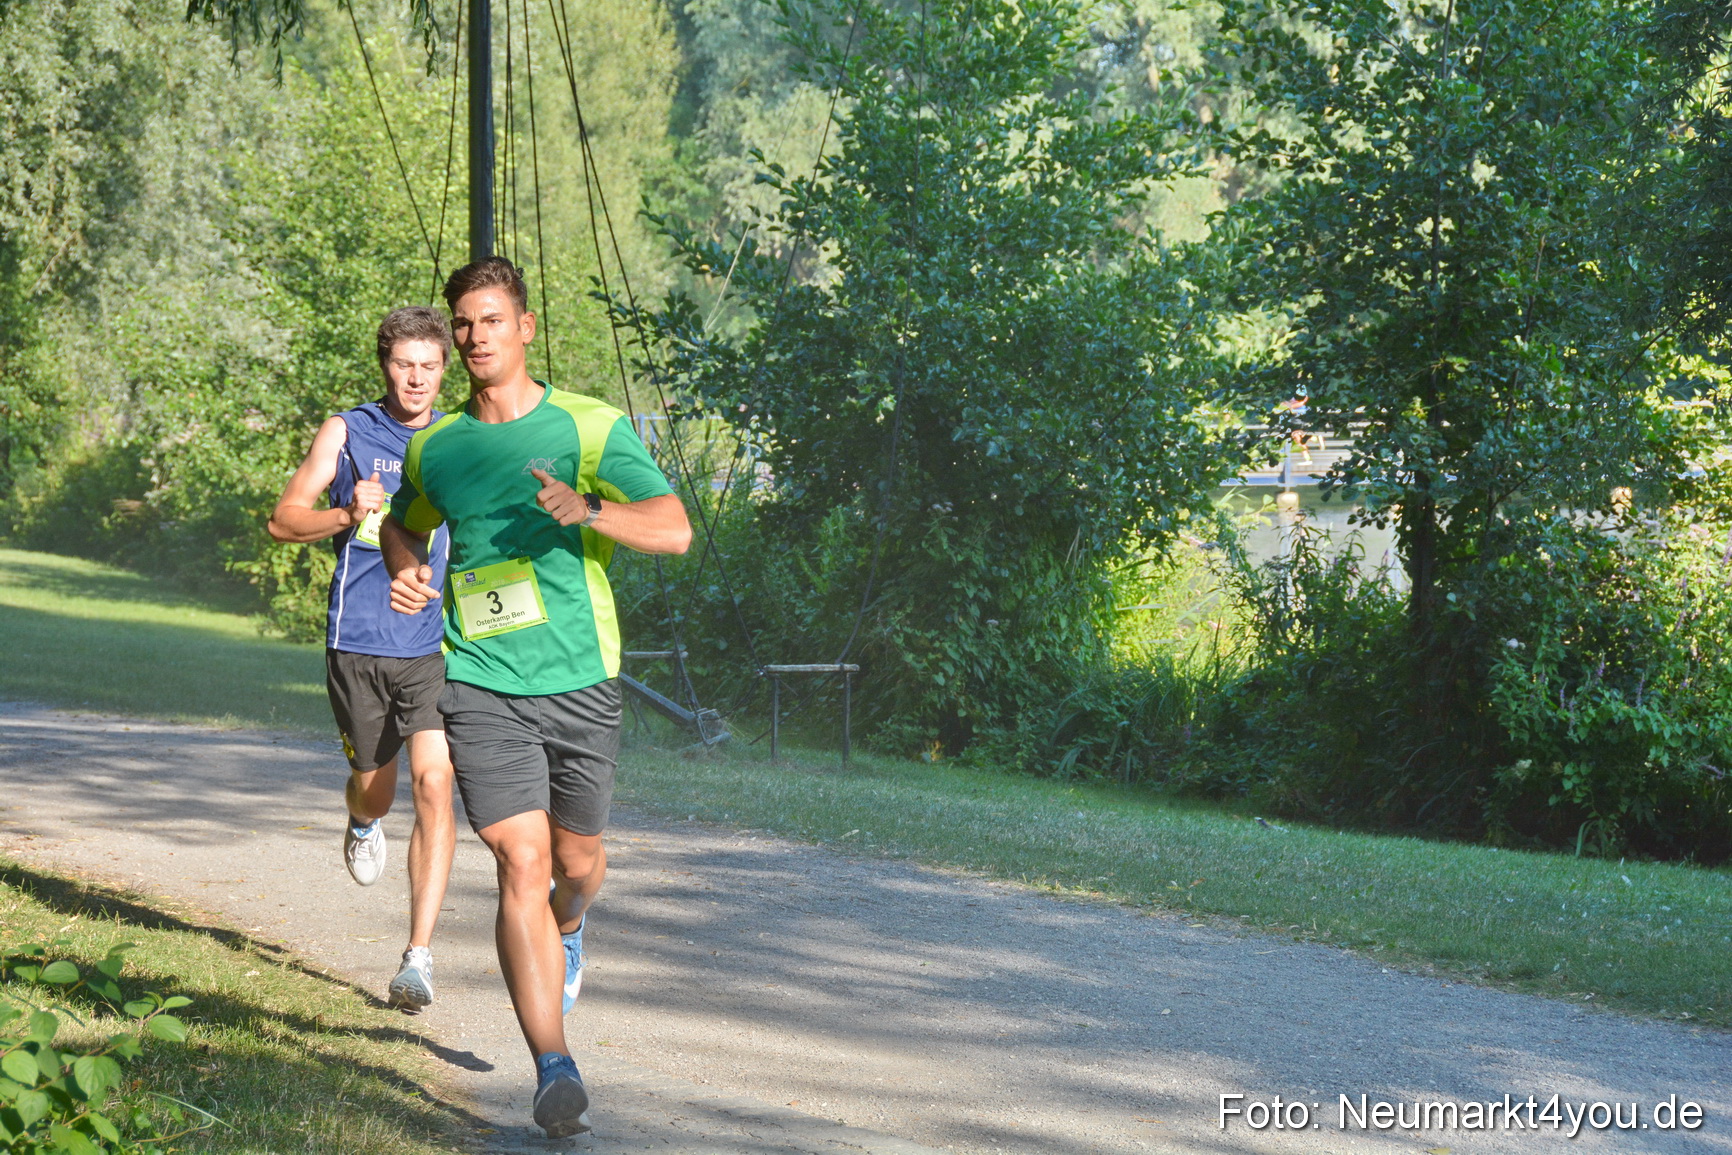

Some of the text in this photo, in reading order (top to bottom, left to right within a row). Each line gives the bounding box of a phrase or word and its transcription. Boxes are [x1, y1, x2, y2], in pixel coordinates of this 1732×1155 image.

[522, 457, 558, 472] AOK
[486, 590, 503, 615] 3
[475, 610, 526, 627] Osterkamp Ben
